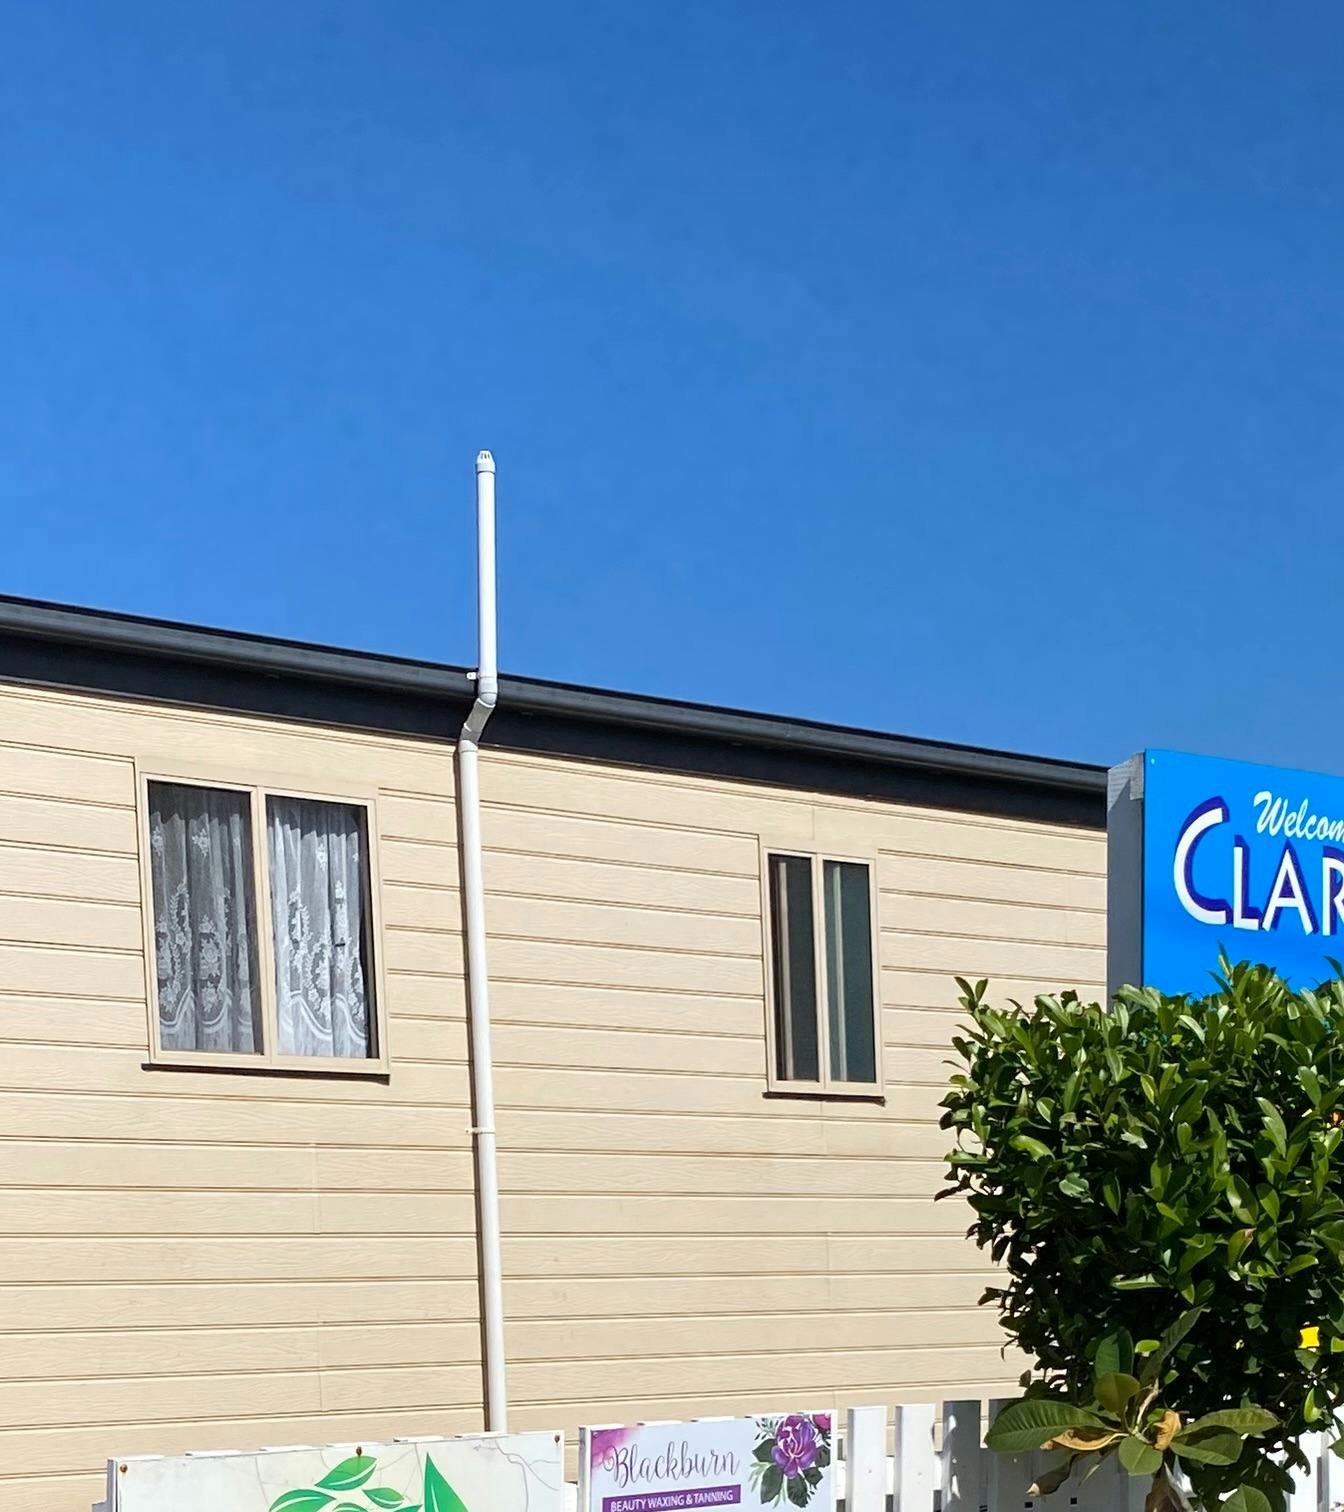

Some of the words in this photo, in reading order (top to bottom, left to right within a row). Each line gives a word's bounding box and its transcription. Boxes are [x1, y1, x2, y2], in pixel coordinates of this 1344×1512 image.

[603, 1440, 741, 1489] Blackburn
[610, 1499, 646, 1512] BEAUTY
[648, 1494, 683, 1509] WAXING
[685, 1495, 693, 1505] &
[693, 1489, 734, 1504] TANNING
